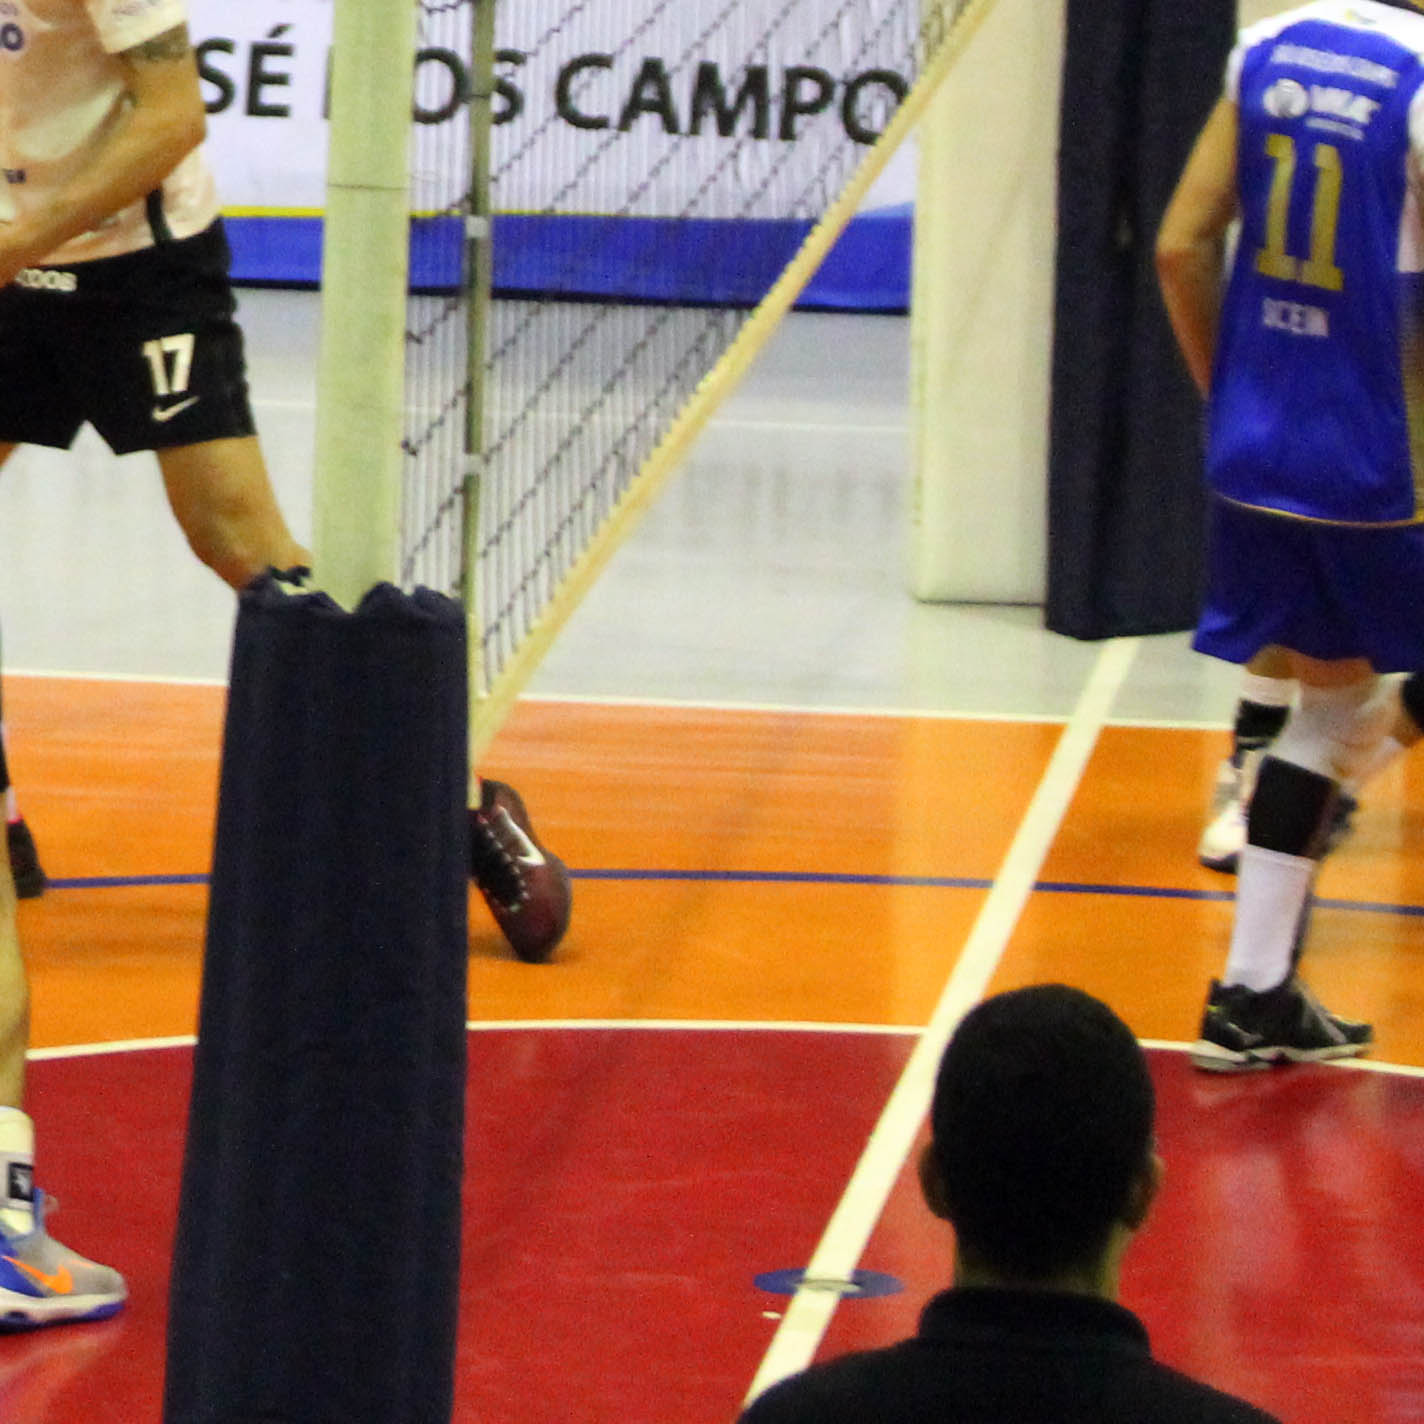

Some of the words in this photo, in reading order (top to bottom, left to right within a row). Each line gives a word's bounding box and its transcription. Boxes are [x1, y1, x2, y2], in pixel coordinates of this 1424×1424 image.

[195, 23, 296, 118] SÉ
[555, 52, 910, 146] CAMPO
[1257, 133, 1345, 292] 11
[143, 333, 195, 395] 17
